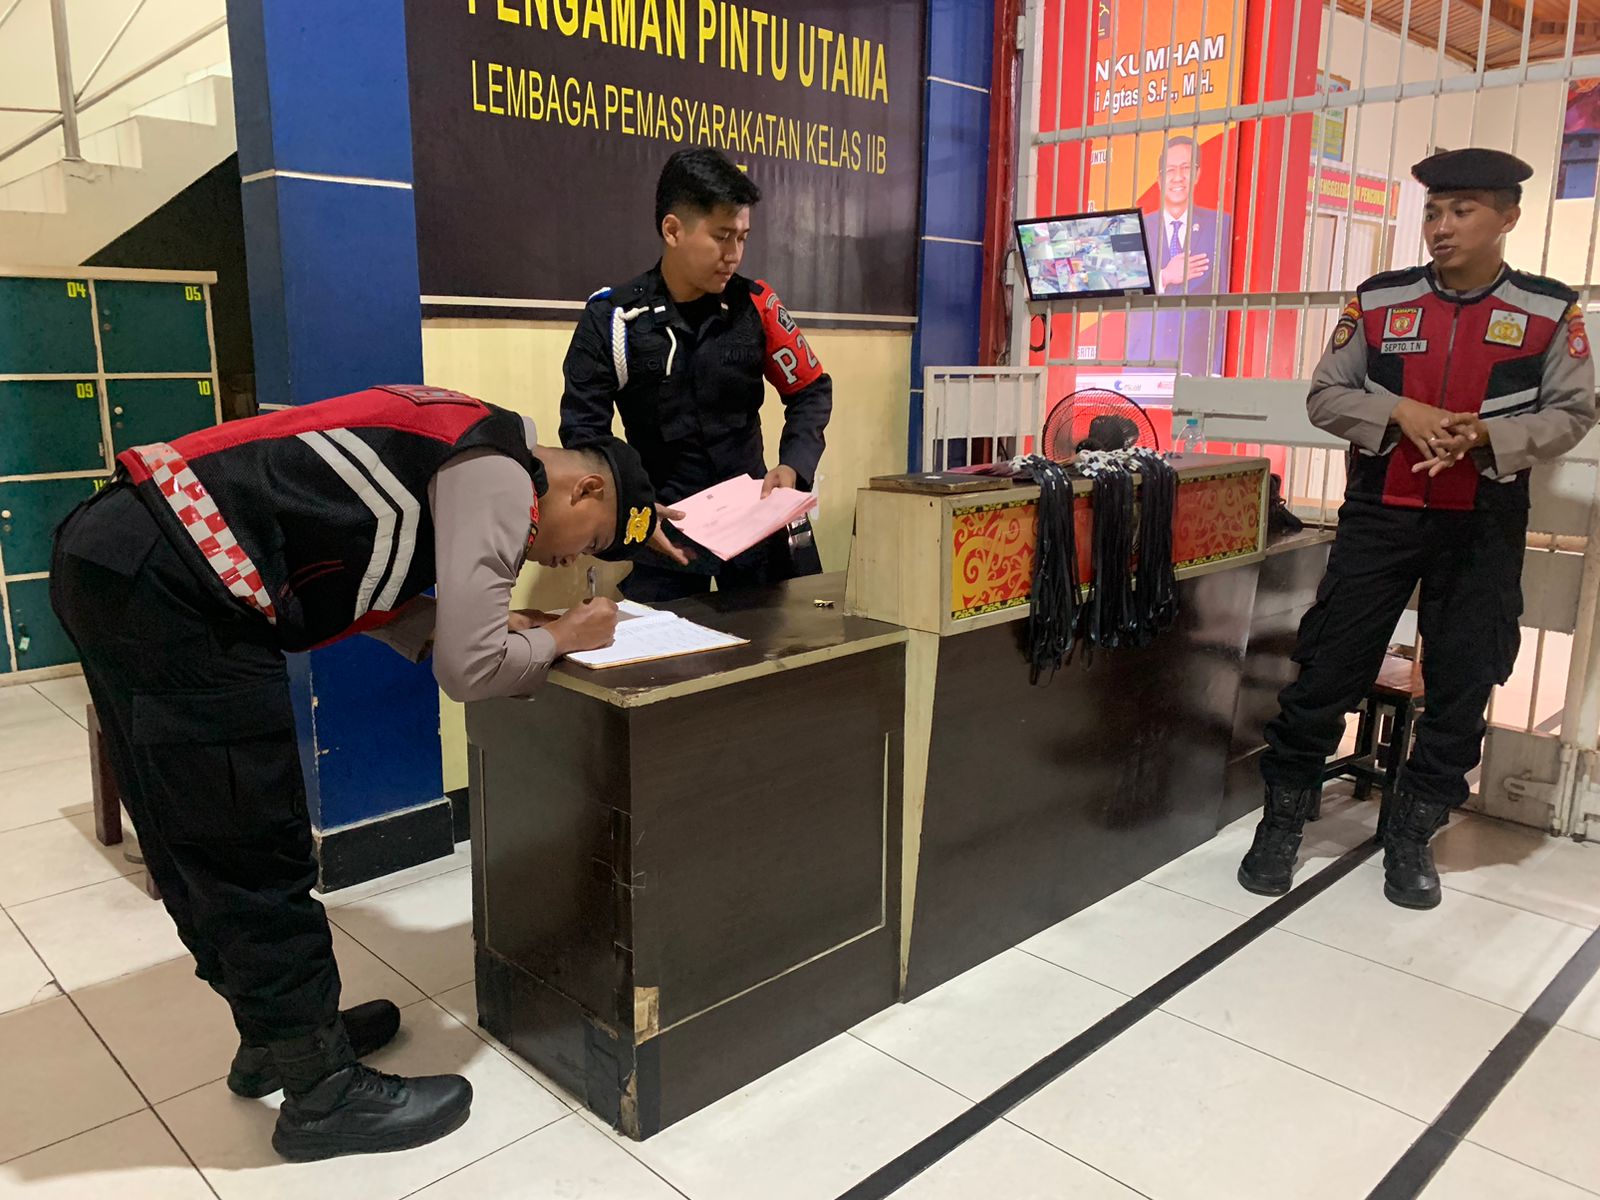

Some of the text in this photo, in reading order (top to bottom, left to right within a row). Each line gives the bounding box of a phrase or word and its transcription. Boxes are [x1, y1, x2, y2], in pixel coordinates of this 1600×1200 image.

[699, 0, 788, 81] PINTU
[799, 22, 889, 104] UTAMA
[471, 59, 887, 175] LEMBAGA PEMASYARAKATAN KELAS IIB
[67, 282, 86, 298] 04
[185, 286, 201, 301] 05
[76, 383, 94, 398] 09
[198, 381, 211, 395] 10
